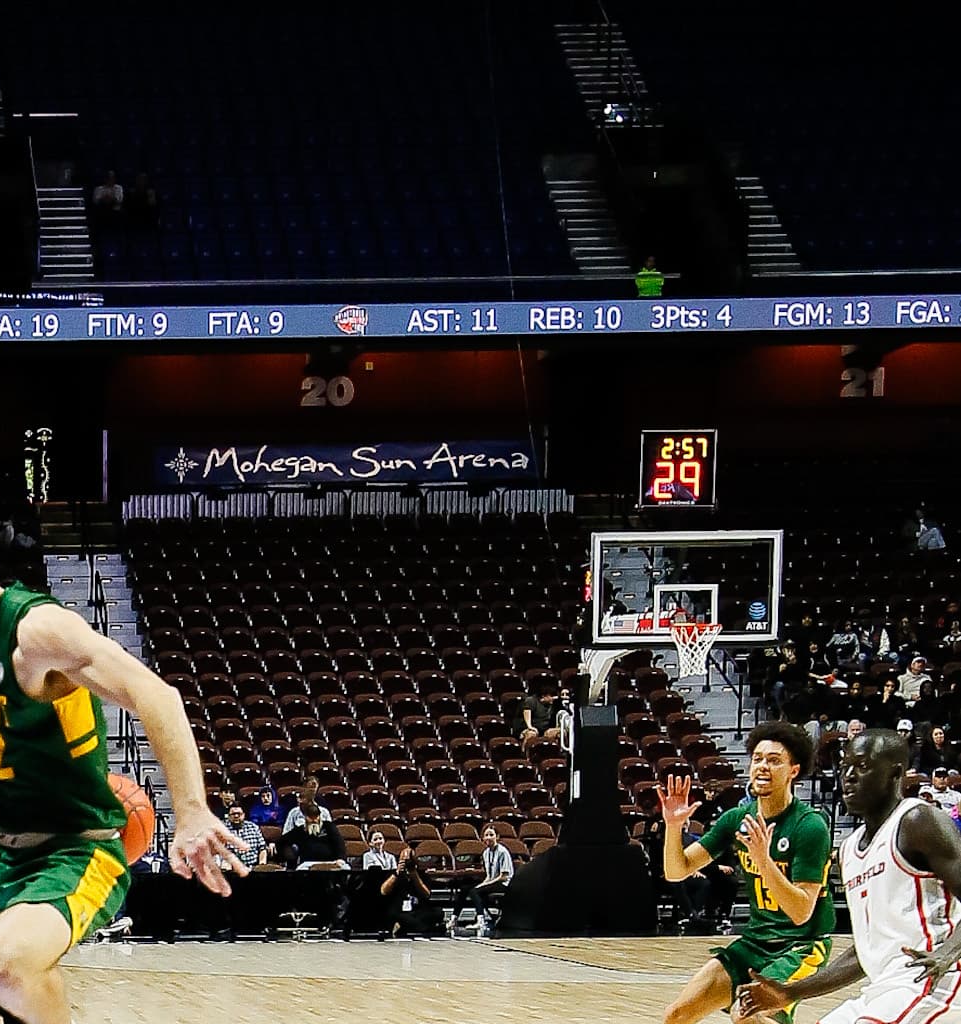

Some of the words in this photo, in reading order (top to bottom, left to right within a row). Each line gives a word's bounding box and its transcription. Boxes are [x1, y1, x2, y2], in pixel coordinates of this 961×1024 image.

[32, 315, 59, 338] 19
[88, 314, 144, 337] FTM:
[153, 313, 167, 336] 9
[208, 312, 260, 335] FTA:
[269, 311, 283, 334] 9
[407, 308, 462, 331] AST:
[471, 307, 497, 330] 11
[529, 307, 583, 330] REB:
[594, 306, 622, 328] 10
[651, 305, 708, 328] 3Pts:
[717, 304, 732, 327] 4
[774, 303, 833, 326] FGM:
[843, 302, 870, 325] 13
[896, 301, 951, 323] FGA:
[301, 376, 355, 406] 20
[840, 367, 885, 397] 21
[202, 446, 343, 481] Mohegan
[349, 446, 416, 478] Sun
[423, 444, 529, 478] Arena
[661, 438, 707, 459] 2:57
[653, 462, 700, 498] 29
[745, 621, 768, 630] AT&T
